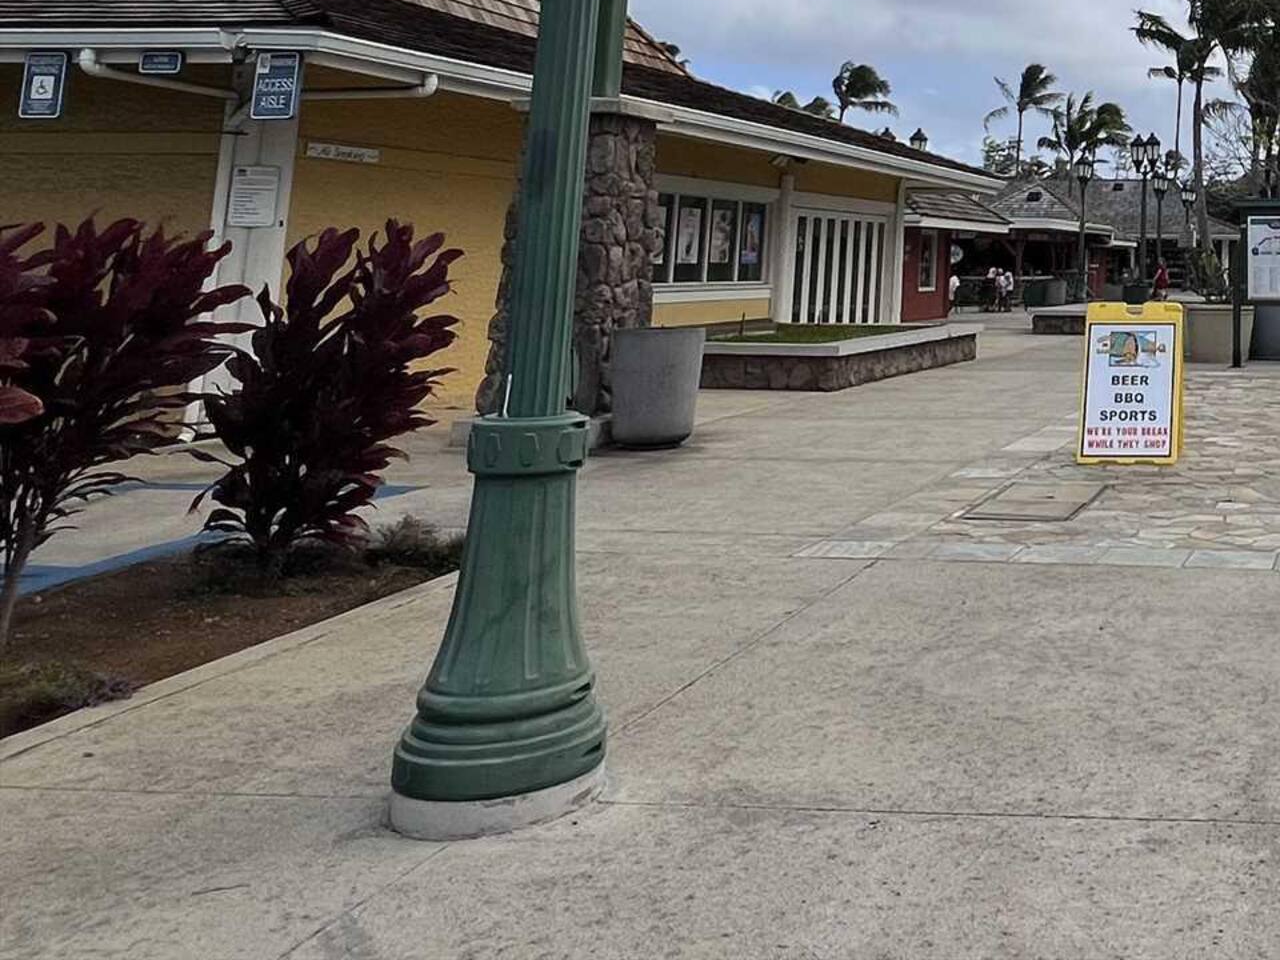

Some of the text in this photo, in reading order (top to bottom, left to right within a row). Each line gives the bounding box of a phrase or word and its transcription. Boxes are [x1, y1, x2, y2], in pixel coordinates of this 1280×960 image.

[258, 78, 294, 91] ACCESS
[260, 95, 286, 109] AISLE
[1111, 375, 1149, 386] BEER
[1114, 393, 1145, 404] BBQ
[1099, 410, 1157, 422] SPORTS
[1117, 427, 1138, 436] YOUR
[1141, 427, 1168, 436] BREAK
[1088, 440, 1113, 449] WHILE
[1118, 440, 1139, 449] THEY
